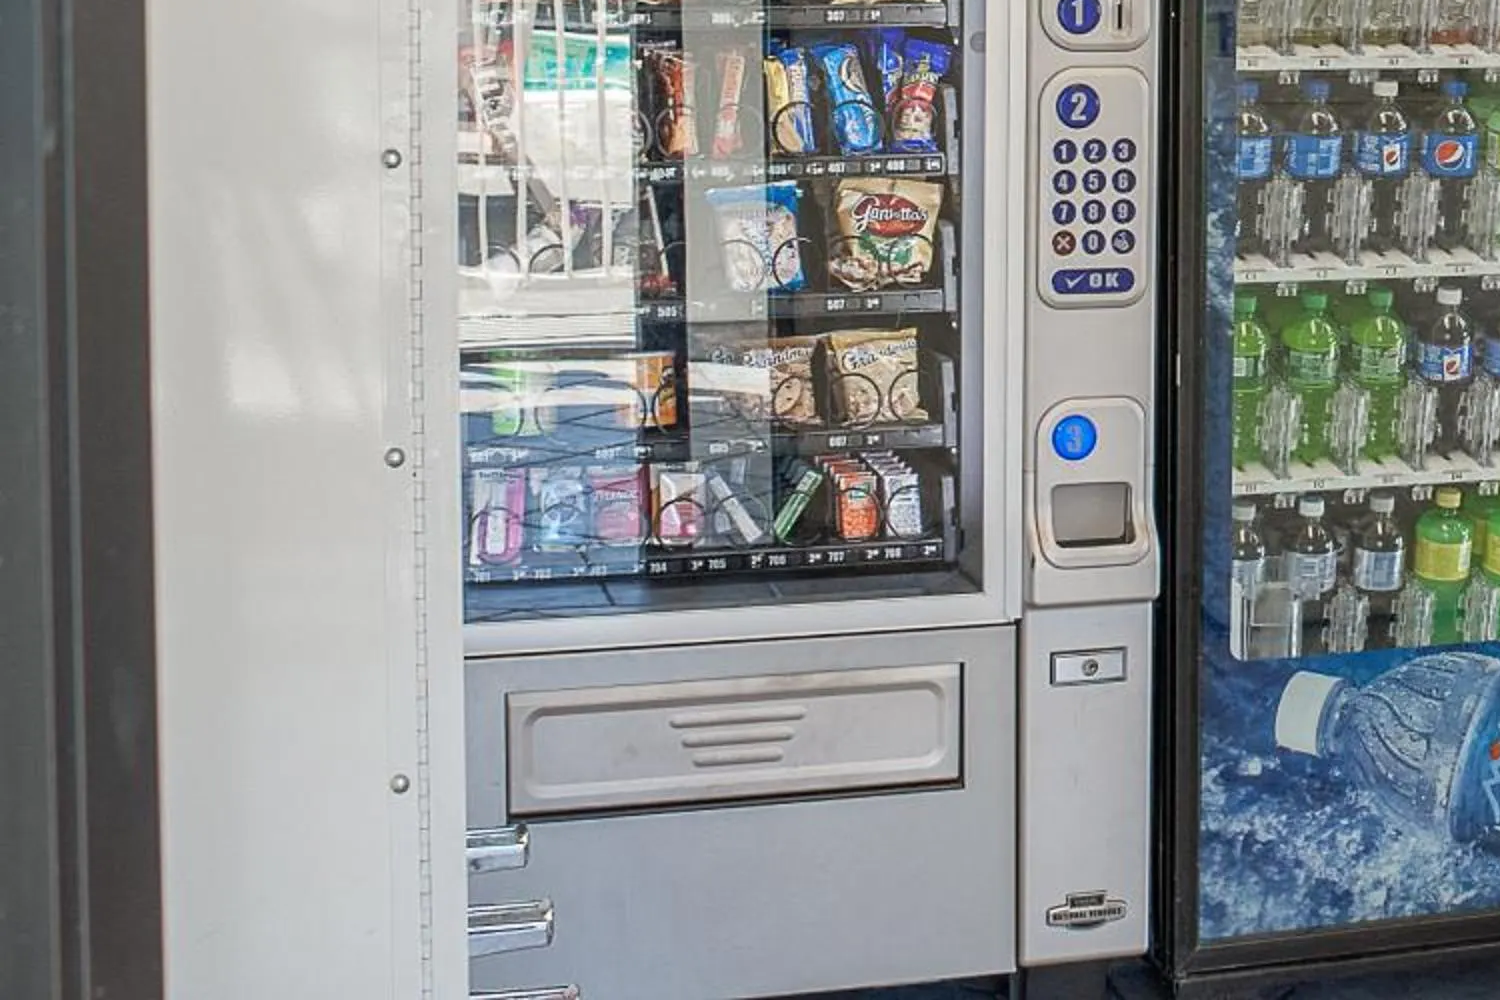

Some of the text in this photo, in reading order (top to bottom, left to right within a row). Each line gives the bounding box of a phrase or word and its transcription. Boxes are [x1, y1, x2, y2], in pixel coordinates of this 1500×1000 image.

[1070, 91, 1087, 121] 2
[1060, 143, 1129, 160] 1 2 3
[1058, 173, 1129, 190] 4 5 6
[1059, 203, 1128, 220] 7 8 9
[1089, 234, 1099, 250] 0
[1089, 273, 1119, 287] OK
